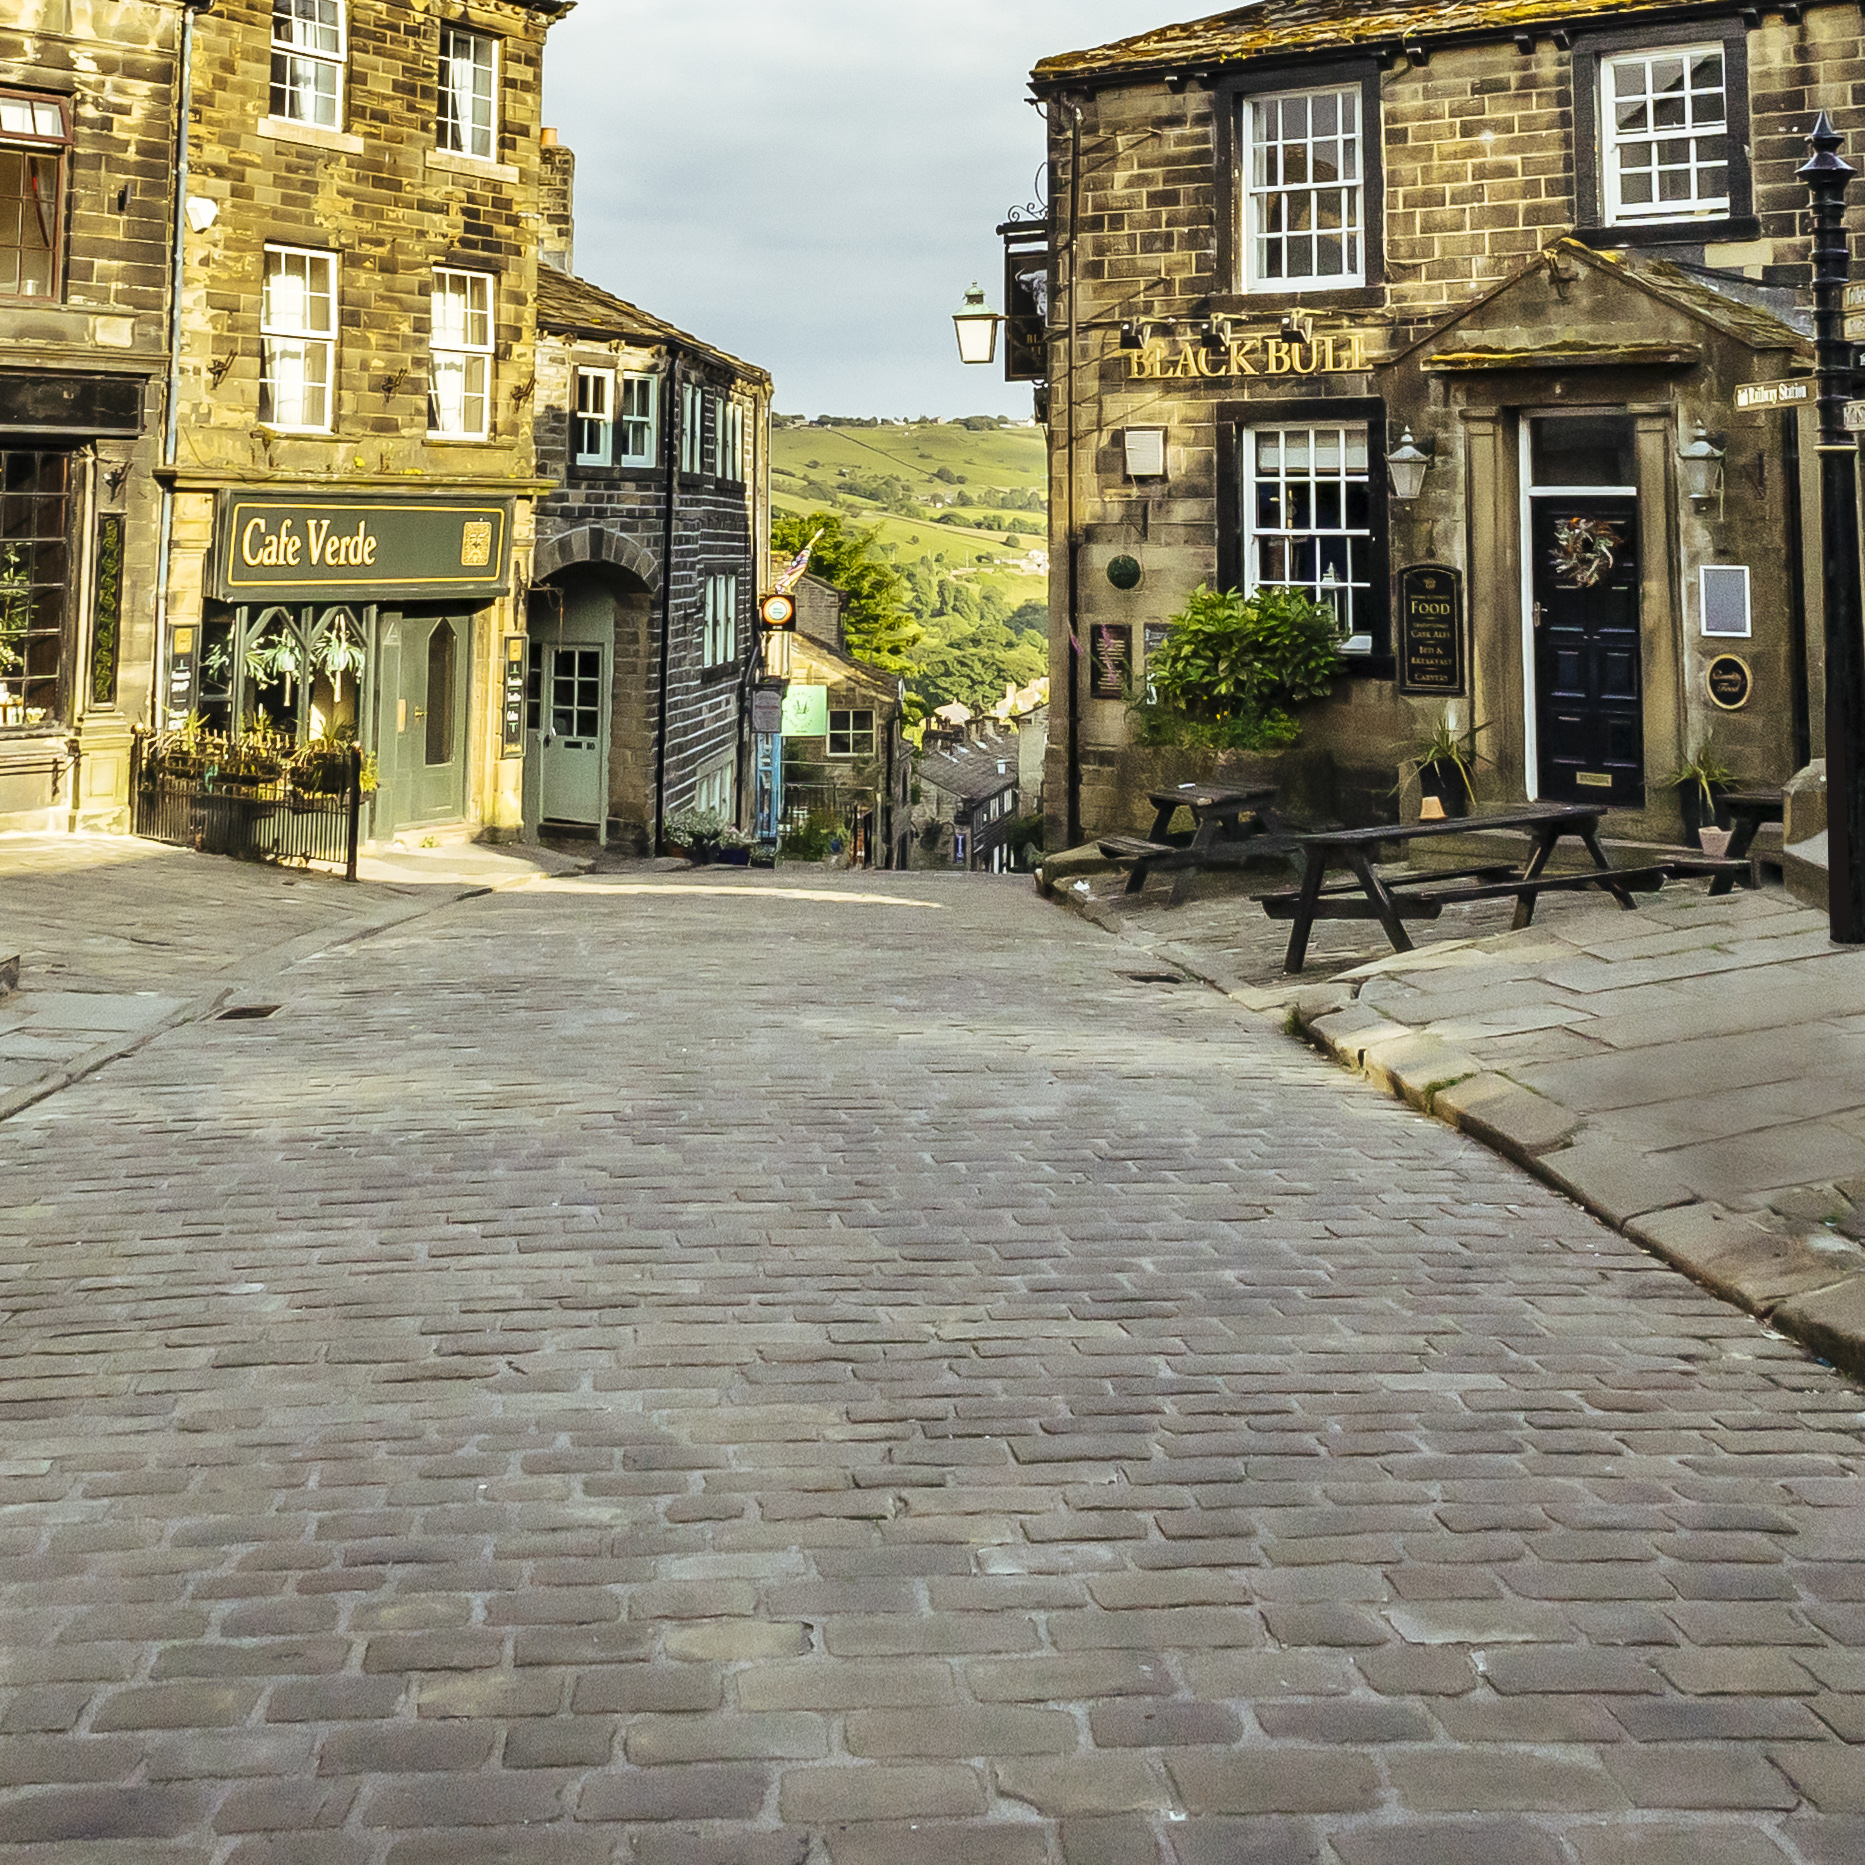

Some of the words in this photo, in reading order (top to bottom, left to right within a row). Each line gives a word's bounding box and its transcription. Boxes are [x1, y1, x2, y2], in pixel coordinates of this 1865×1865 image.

[1127, 339, 1260, 379] BLACK
[1264, 334, 1375, 374] BULL
[1778, 383, 1808, 401] Station
[242, 517, 303, 567] Cafe
[306, 518, 378, 567] Verde
[1411, 600, 1450, 615] FOOD
